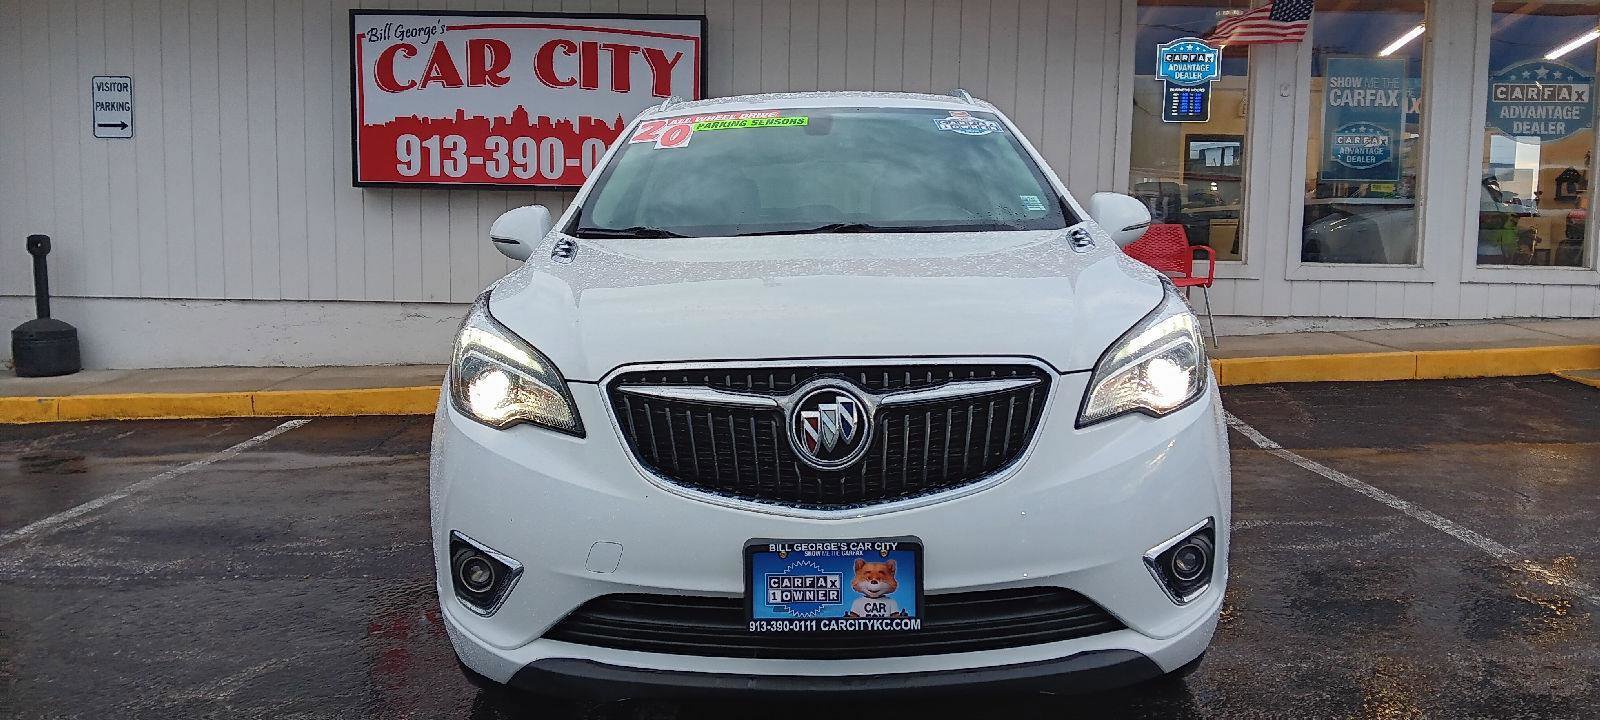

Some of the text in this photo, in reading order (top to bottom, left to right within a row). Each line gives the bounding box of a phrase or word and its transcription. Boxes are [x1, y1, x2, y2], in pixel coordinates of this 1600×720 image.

[367, 19, 446, 44] Bill George's
[1165, 54, 1214, 62] CARFAX
[374, 39, 684, 98] CAR CITY
[96, 82, 128, 92] VISITOR
[1330, 77, 1399, 89] SHOW ME THE
[1329, 88, 1399, 107] CARFAX
[1496, 86, 1585, 102] CARFAX
[95, 101, 130, 112] PARKING
[1500, 106, 1580, 119] ADVANTAGE
[694, 113, 737, 123] WHEEL
[738, 111, 779, 119] DRIVE
[696, 117, 806, 130] PARKING SENSORS
[1513, 121, 1566, 134] DEALER
[1337, 136, 1388, 146] CARFAX
[396, 134, 611, 180] 913-390-0
[1340, 147, 1384, 155] ADVANTAGE
[1346, 155, 1376, 163] DEALER
[769, 541, 897, 552] BILL GEORGE'S CAR CITY
[770, 577, 839, 588] CARFAX
[864, 602, 886, 613] CAR
[750, 618, 921, 632] 913-390-0111 CARCITYKC.COM
